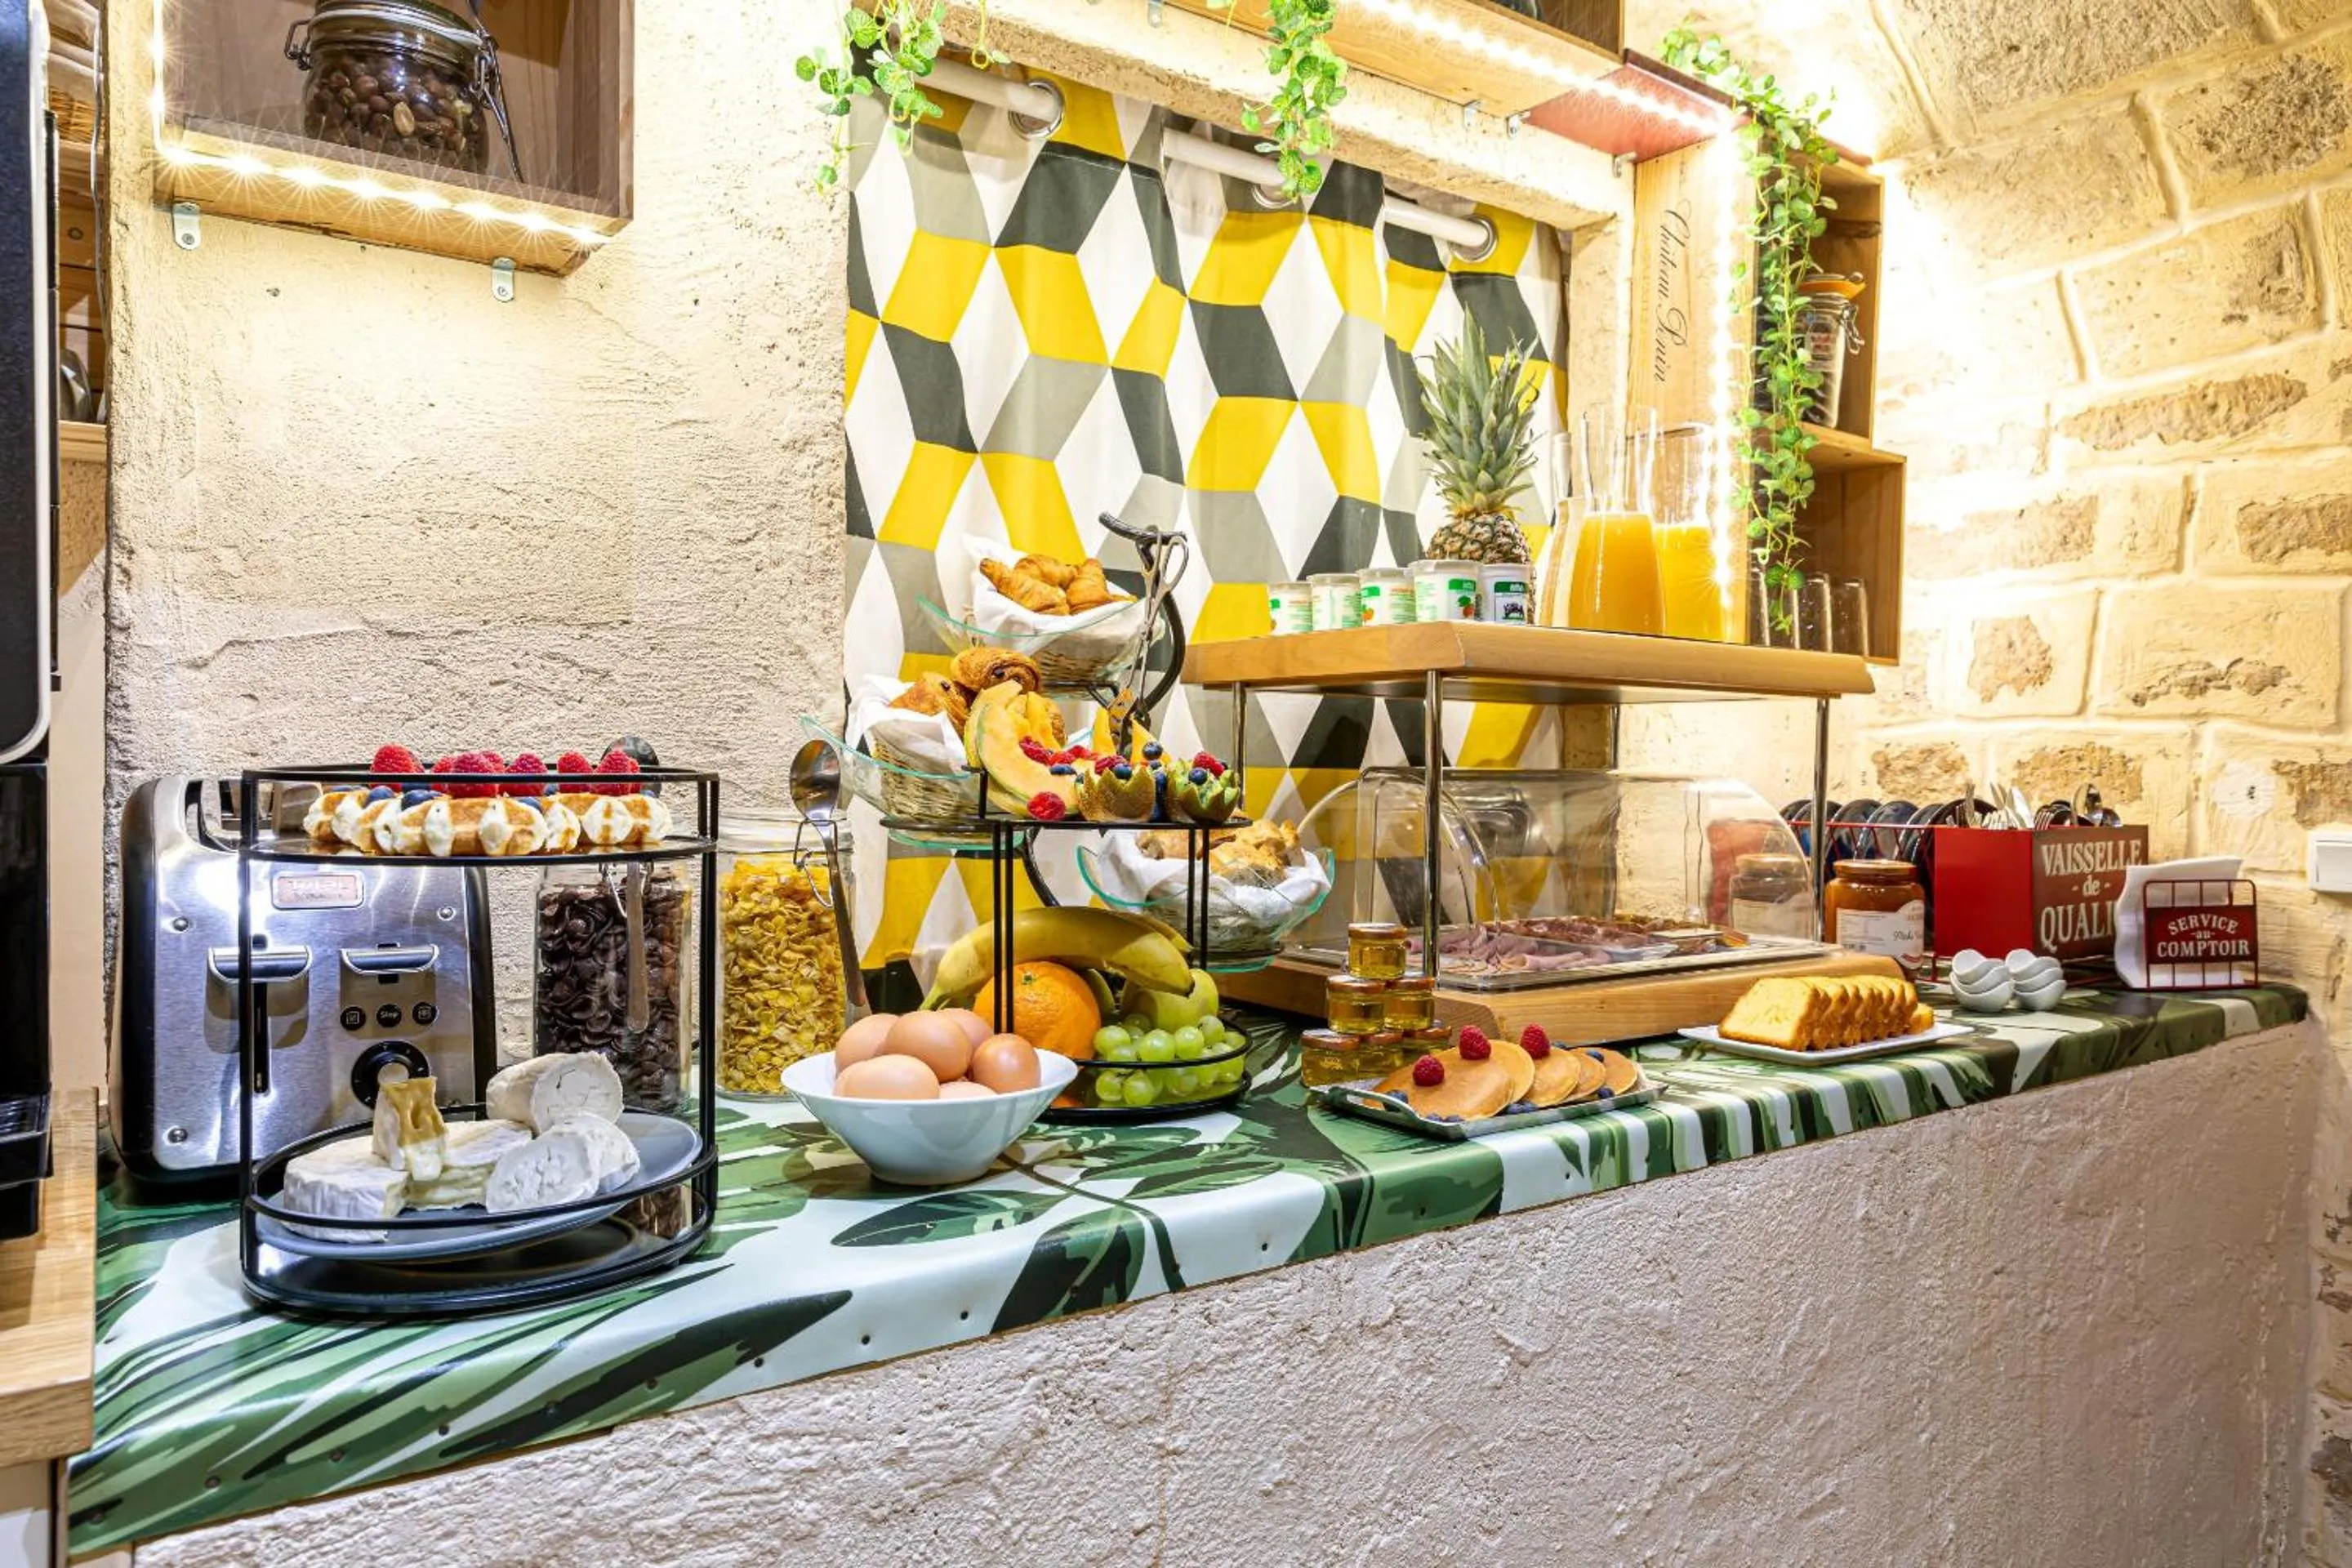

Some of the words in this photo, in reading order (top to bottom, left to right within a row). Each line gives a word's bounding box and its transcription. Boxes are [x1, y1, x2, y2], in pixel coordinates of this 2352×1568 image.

[2041, 839, 2142, 877] VAISSELLE
[2040, 900, 2114, 954] QUALI
[2167, 913, 2238, 935] SERVICE
[2157, 939, 2251, 958] COMPTOIR
